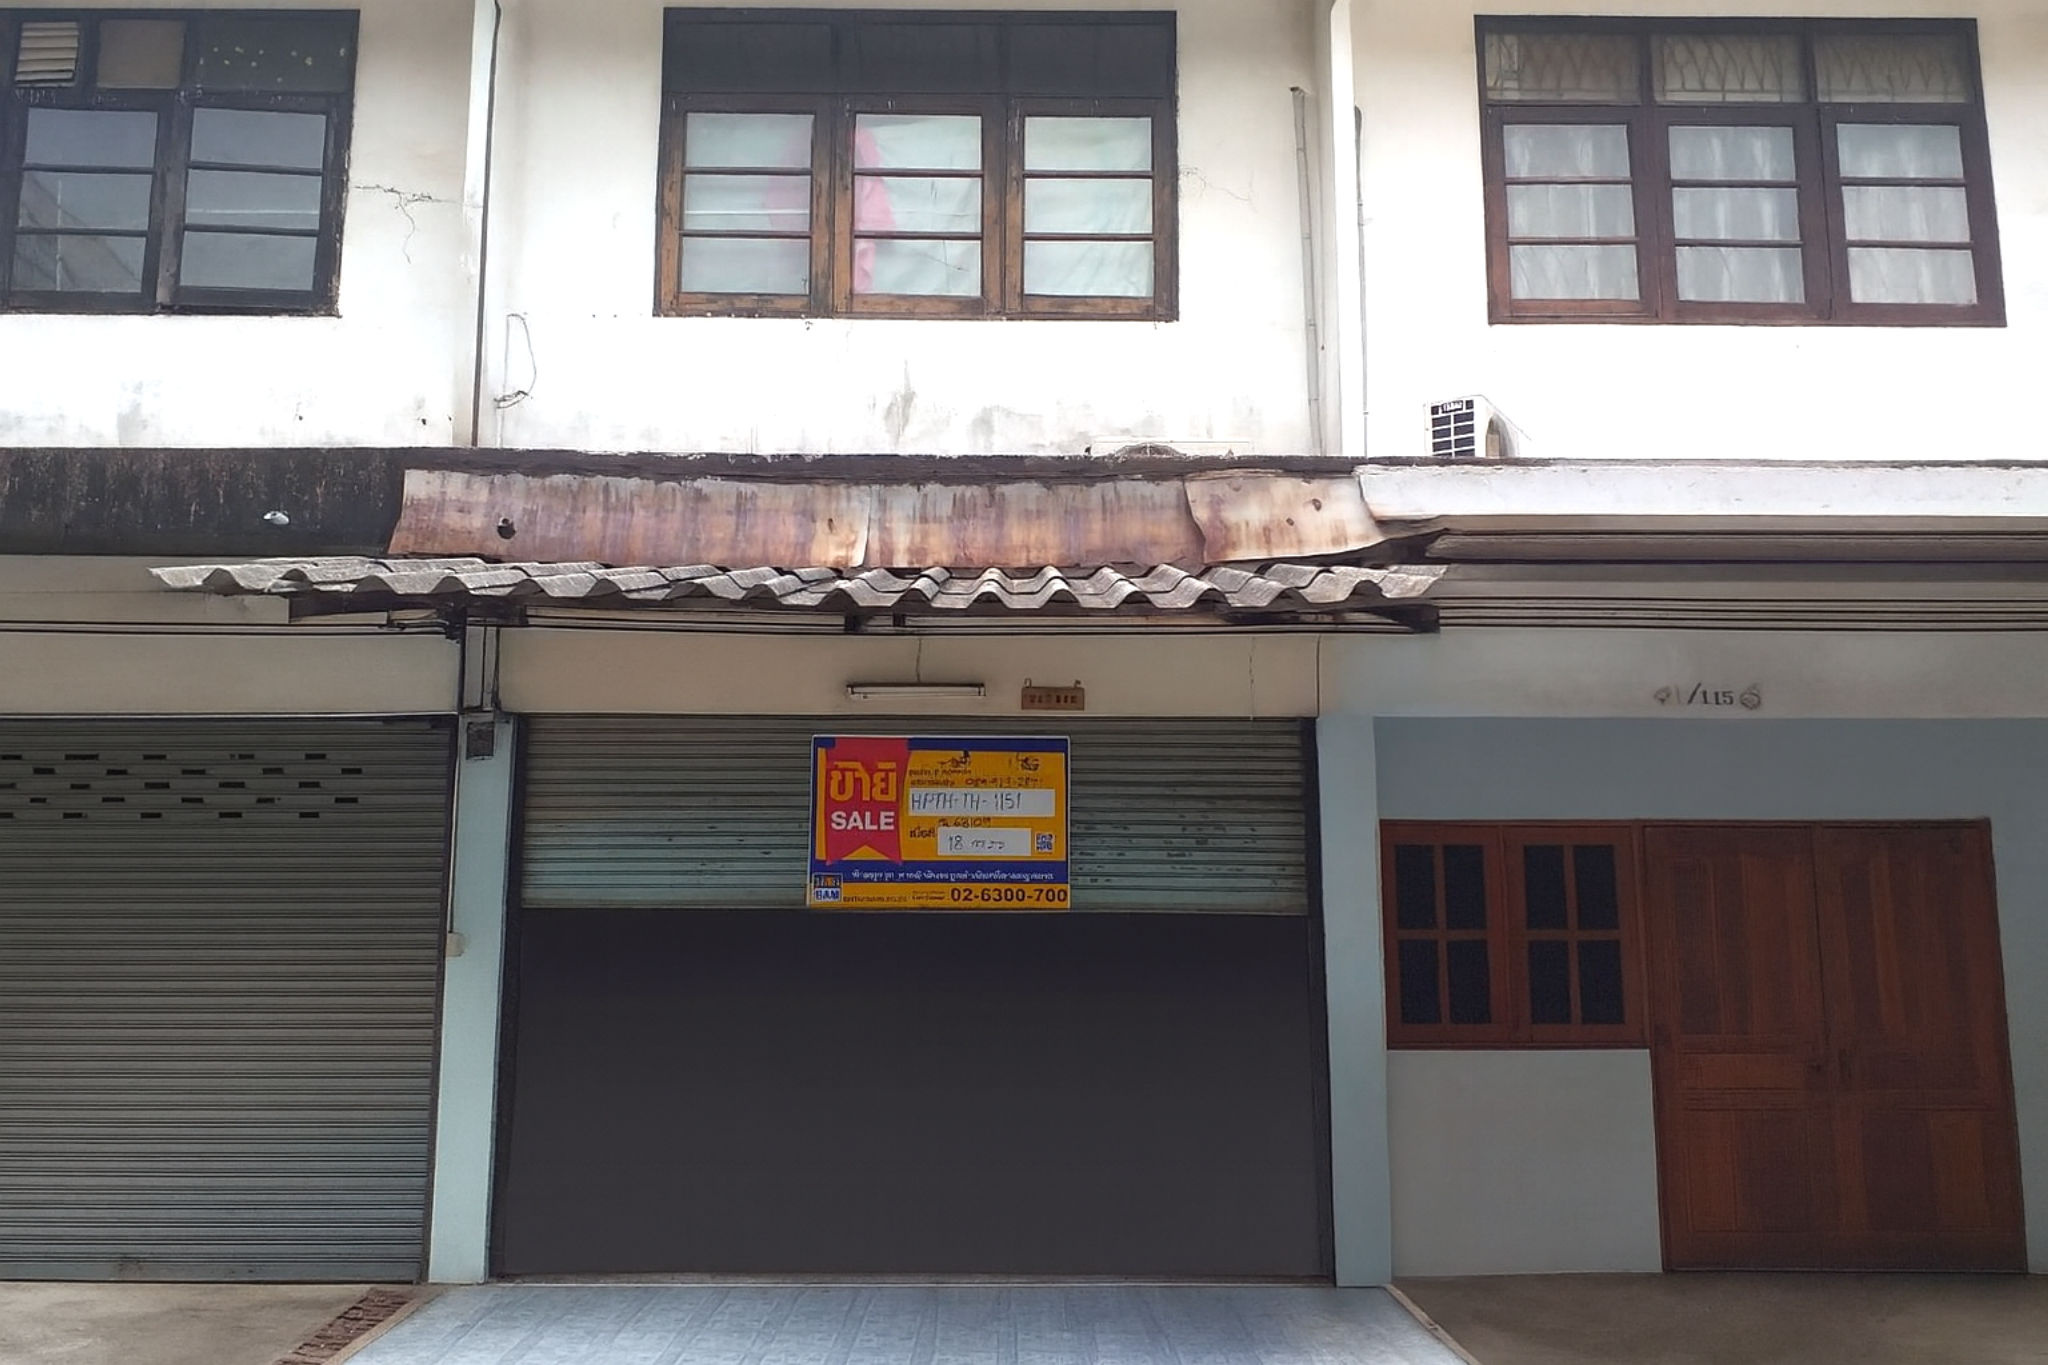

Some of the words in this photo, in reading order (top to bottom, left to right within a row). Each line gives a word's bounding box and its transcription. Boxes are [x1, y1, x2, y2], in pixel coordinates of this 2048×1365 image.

[829, 761, 897, 802] ขาย
[830, 811, 896, 831] SALE
[950, 887, 1068, 903] 02-6300-700
